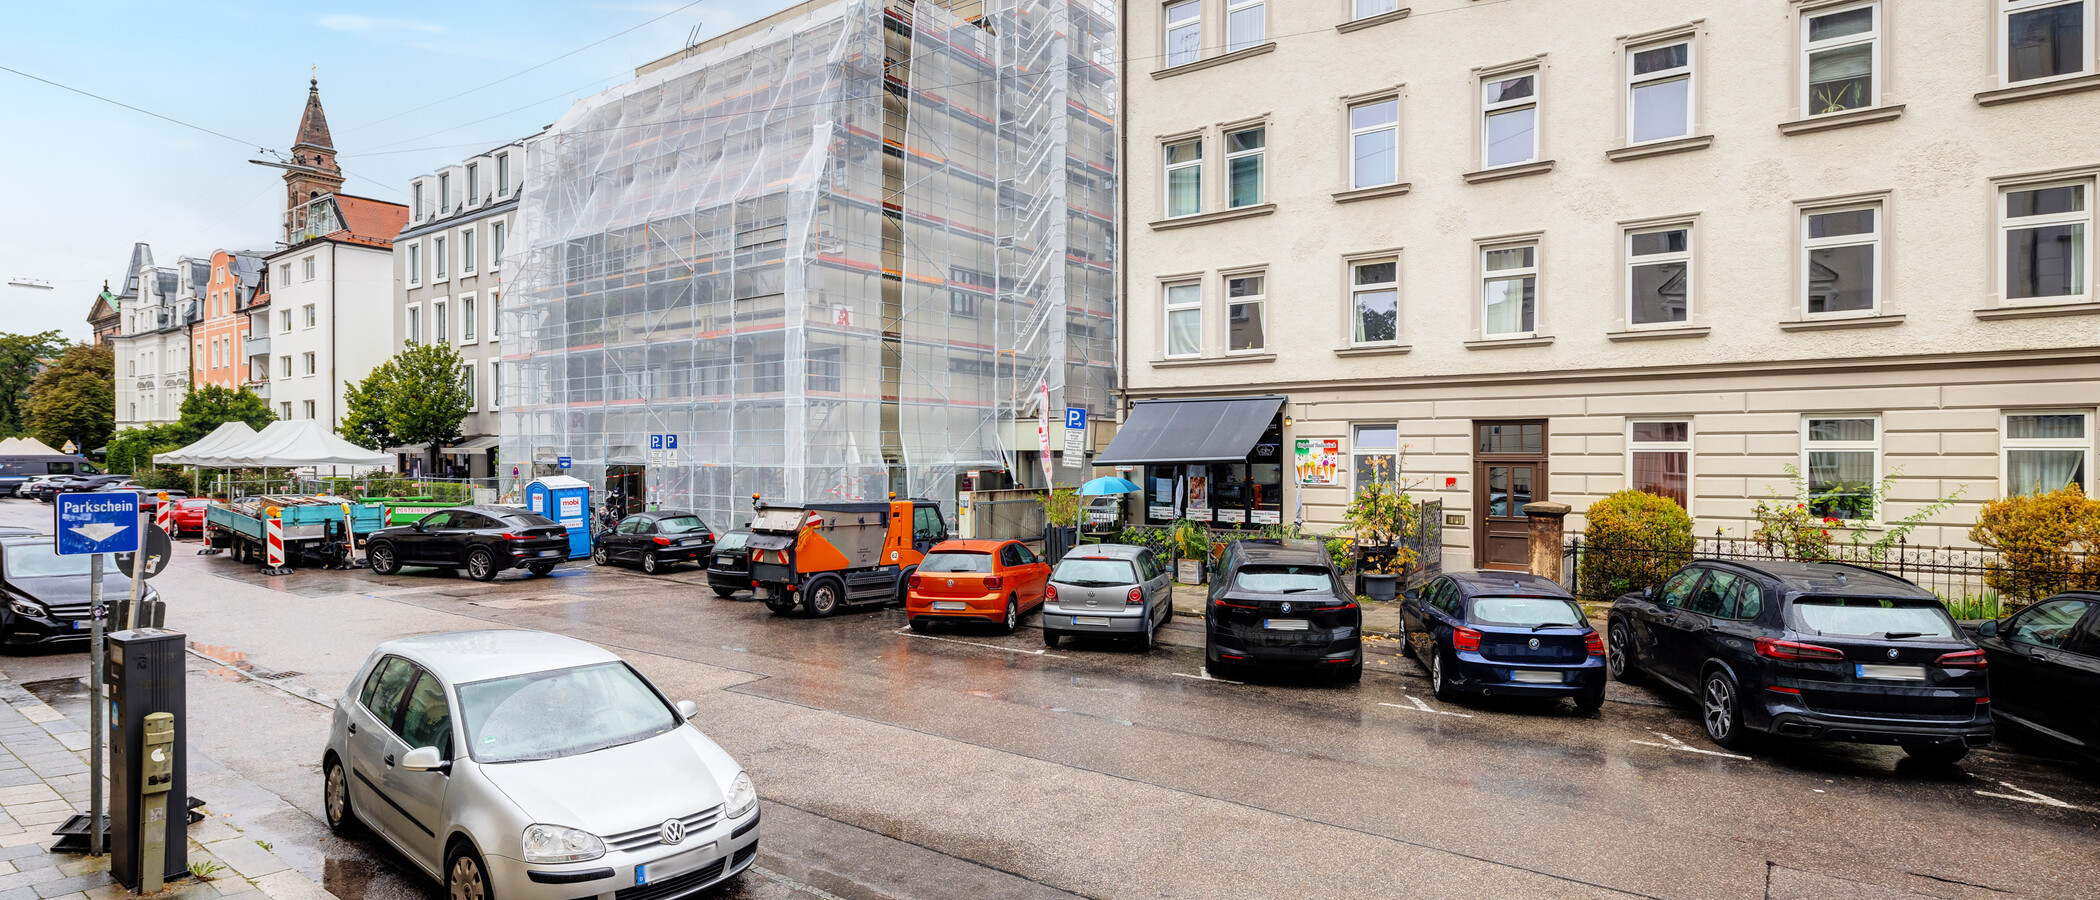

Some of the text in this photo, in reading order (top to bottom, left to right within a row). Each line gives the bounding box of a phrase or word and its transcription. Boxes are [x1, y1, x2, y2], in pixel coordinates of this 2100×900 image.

[1069, 410, 1080, 426] P
[652, 436, 659, 447] P
[667, 436, 674, 447] P
[64, 499, 133, 513] Parkschein
